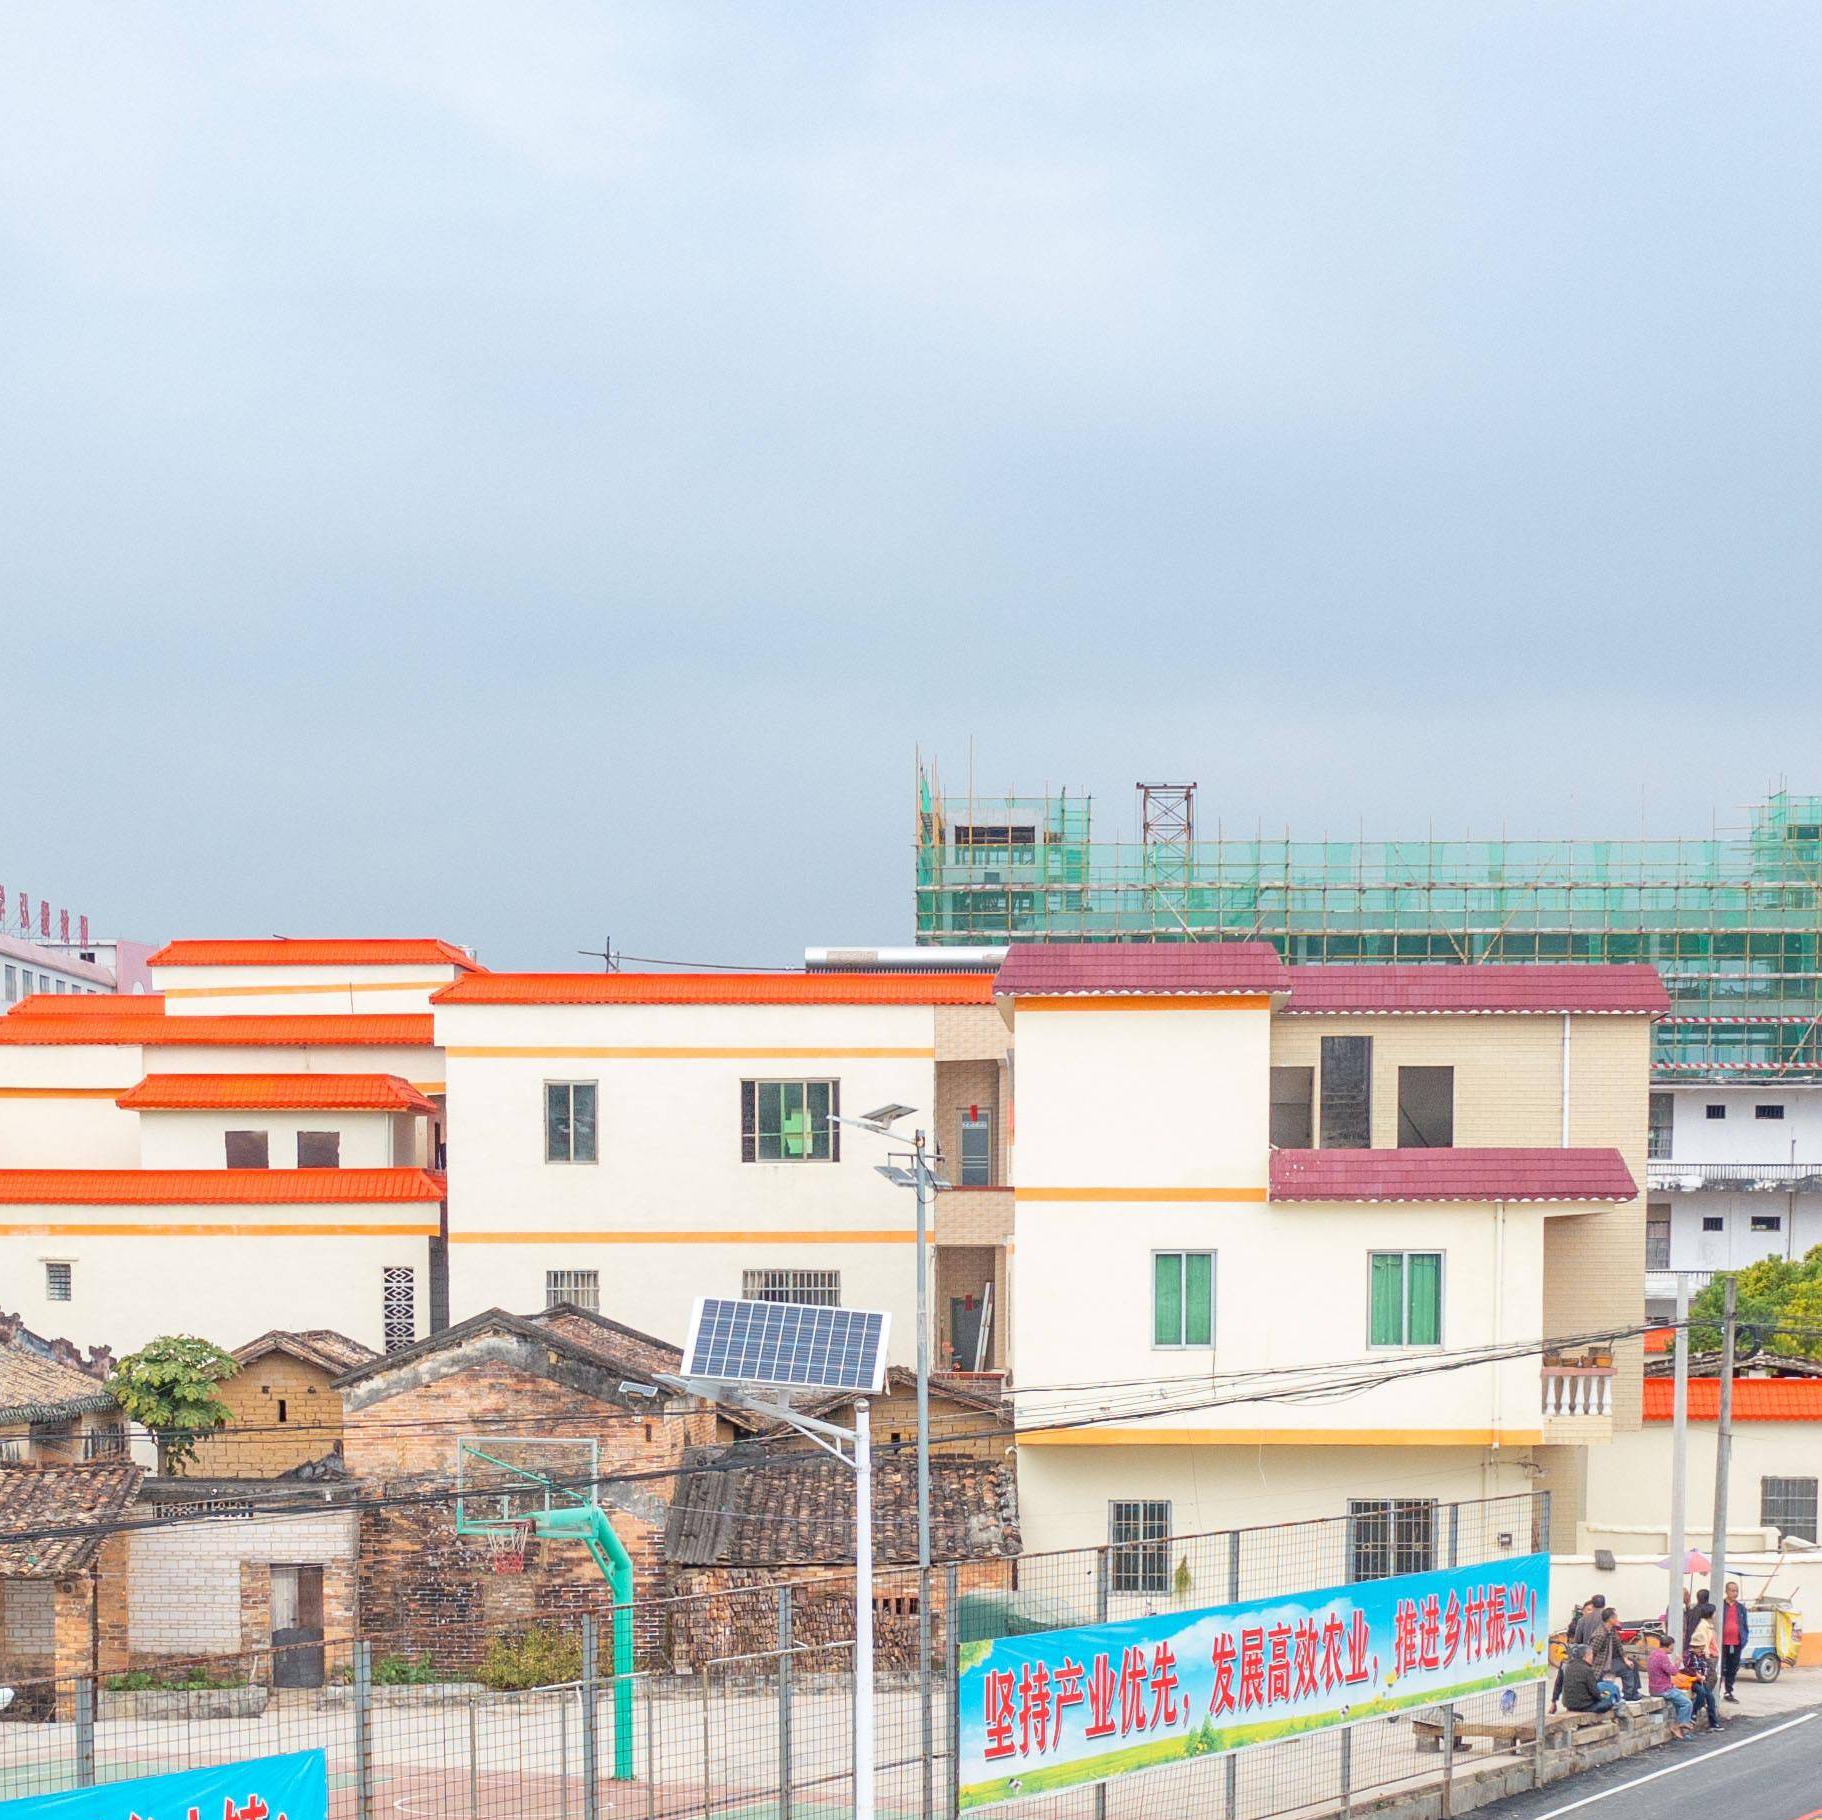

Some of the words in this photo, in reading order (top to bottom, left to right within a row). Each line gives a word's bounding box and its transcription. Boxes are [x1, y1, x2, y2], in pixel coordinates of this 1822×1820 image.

[984, 1582, 1537, 1761] 坚持产业优先，发展高效农业，推进乡村振兴！
